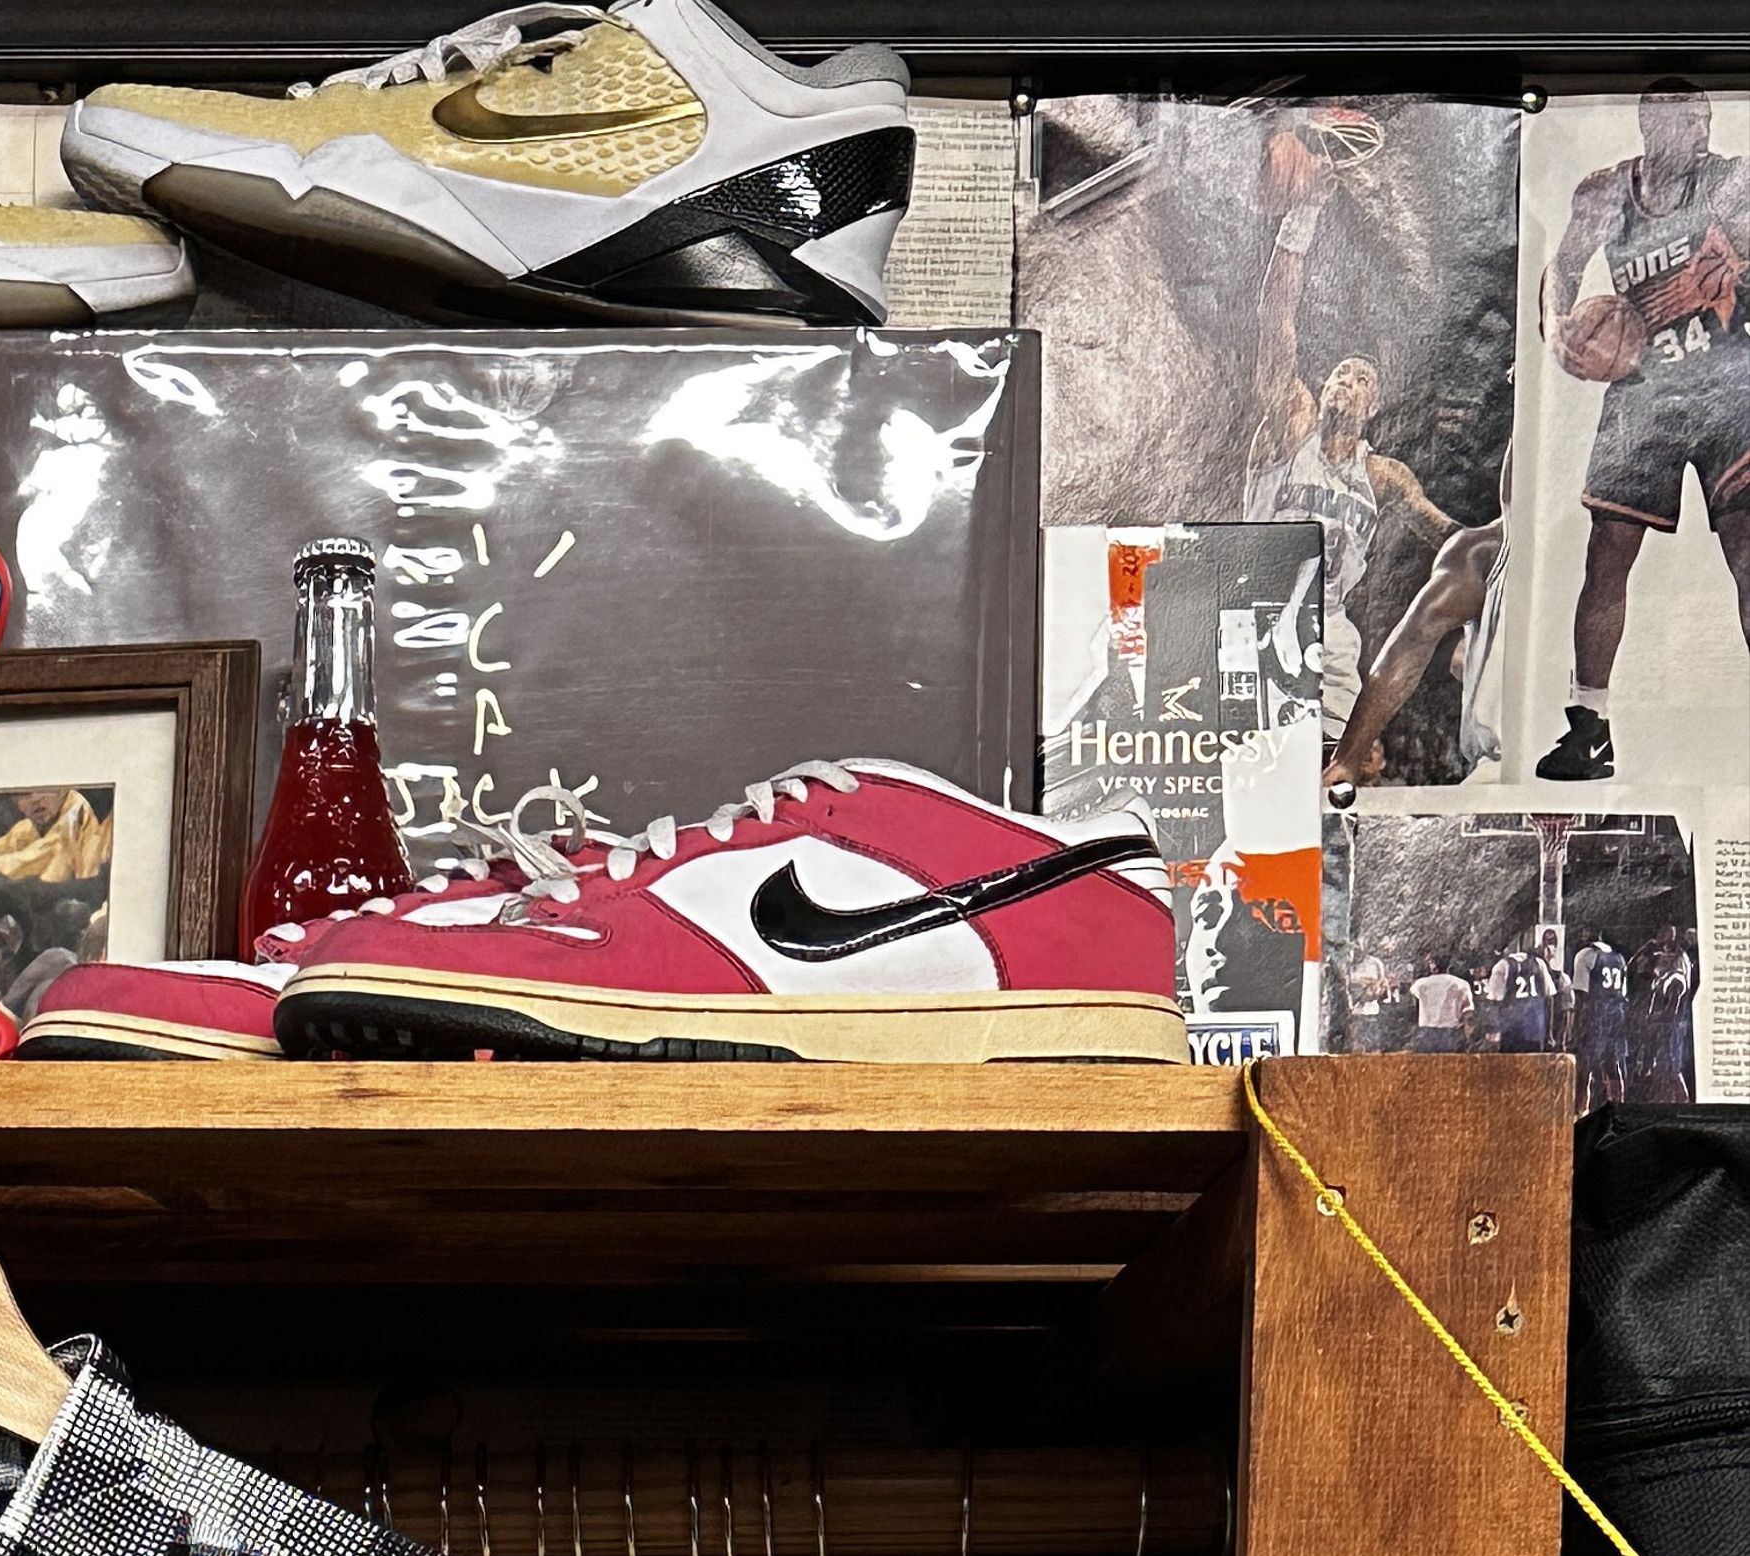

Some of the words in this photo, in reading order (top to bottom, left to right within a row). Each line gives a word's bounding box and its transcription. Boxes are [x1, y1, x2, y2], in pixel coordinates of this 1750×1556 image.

[1653, 316, 1712, 363] 34
[1070, 719, 1288, 773] Hennessy
[1515, 974, 1538, 999] 21
